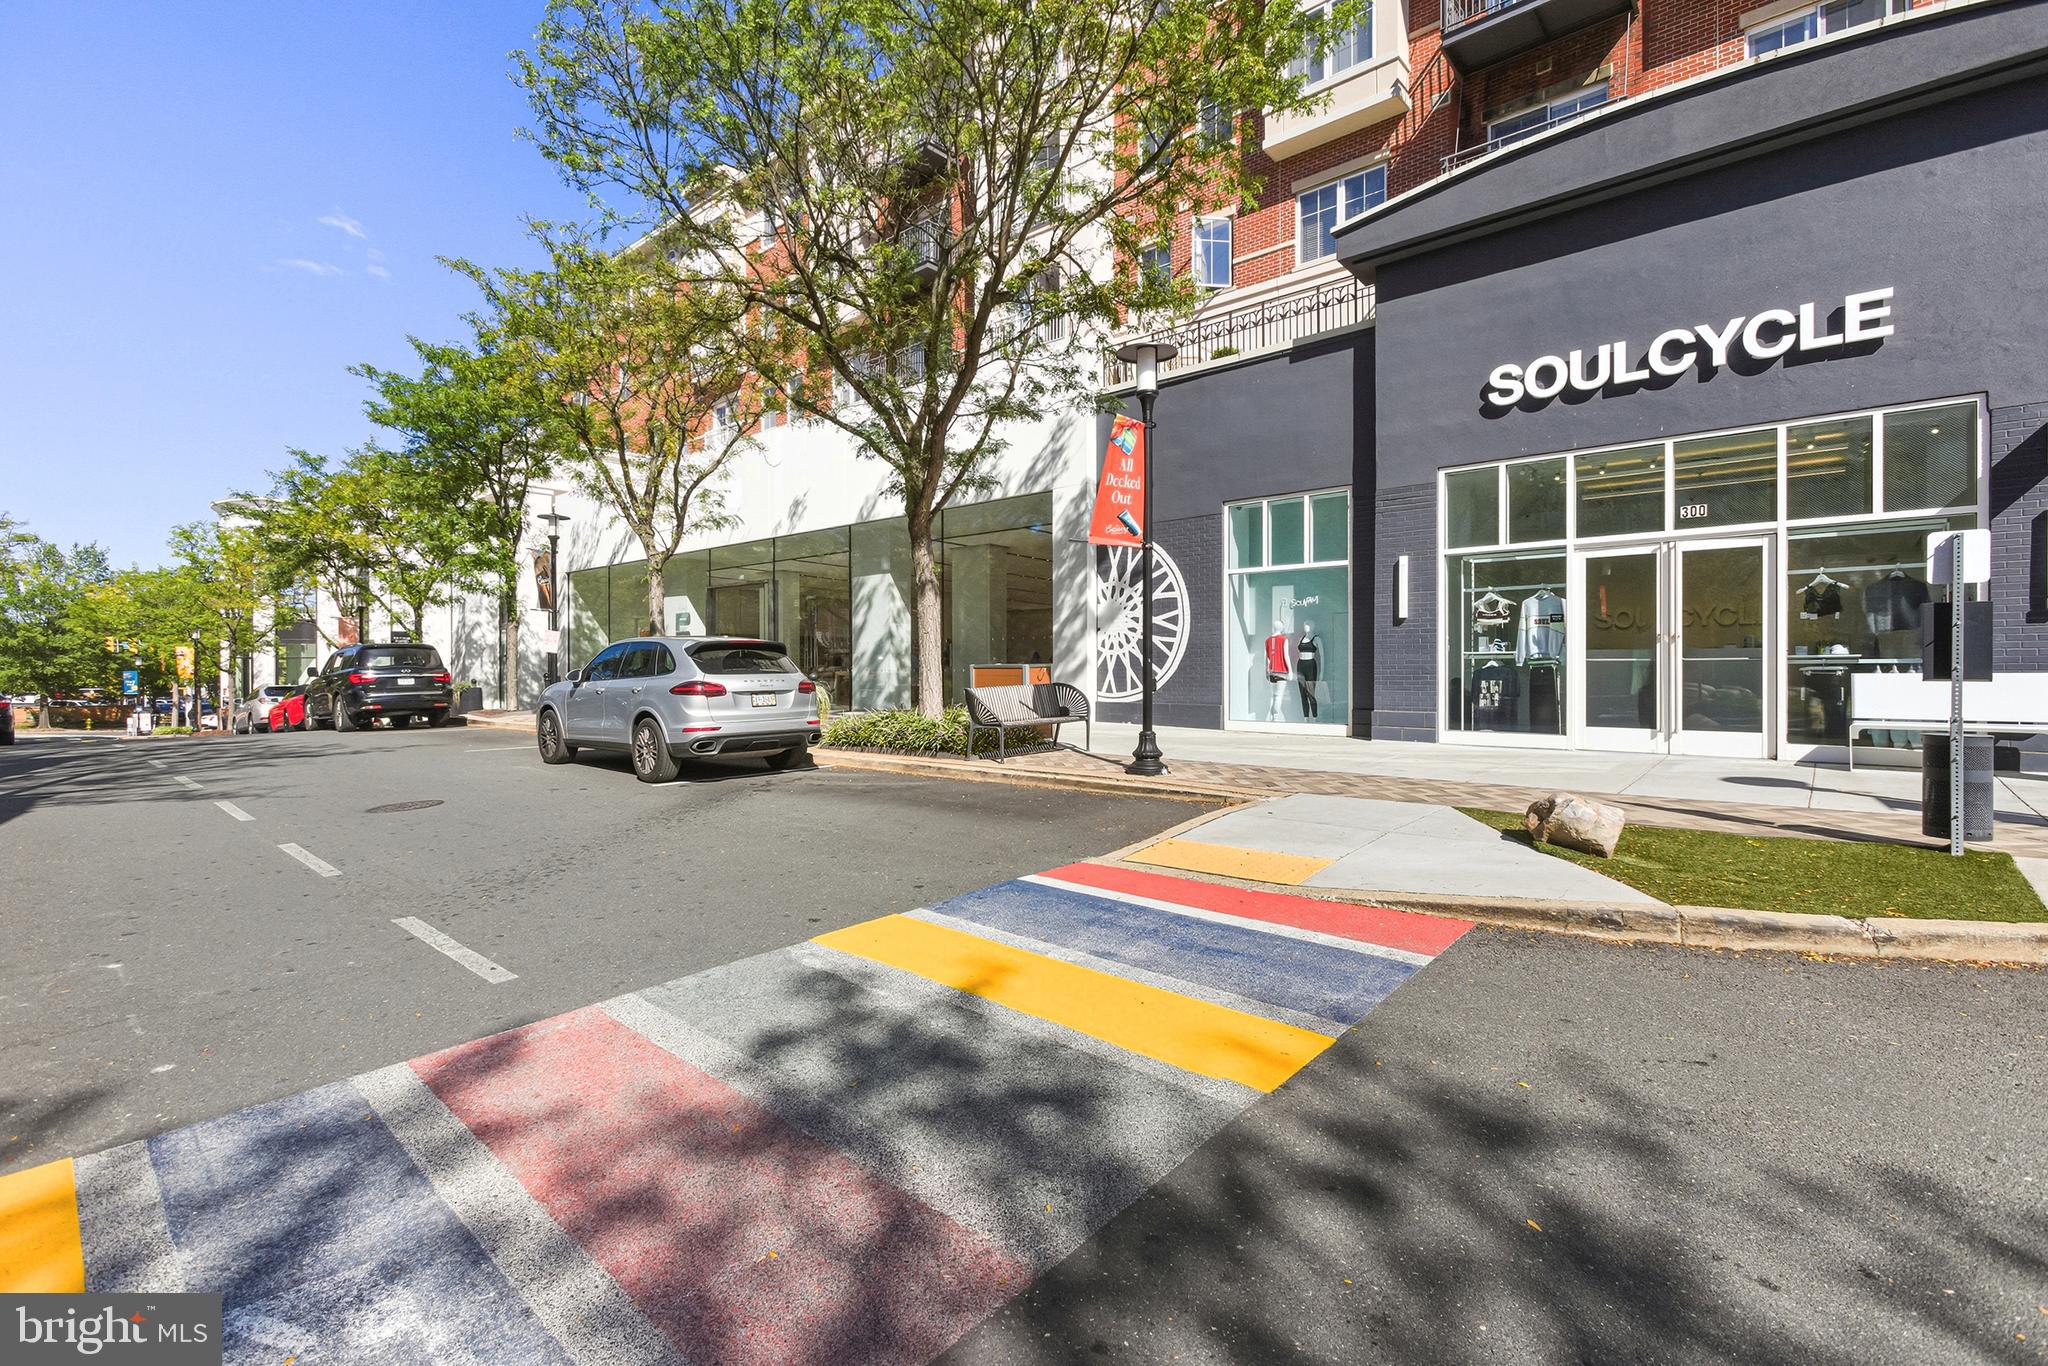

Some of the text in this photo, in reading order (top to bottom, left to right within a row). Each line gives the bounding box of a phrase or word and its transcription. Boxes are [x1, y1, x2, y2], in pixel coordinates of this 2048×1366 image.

[1488, 286, 1895, 406] SOULCYCLE
[1119, 458, 1134, 472] All
[1105, 473, 1141, 490] Decked
[1111, 490, 1132, 505] Out
[1681, 505, 1706, 518] 300
